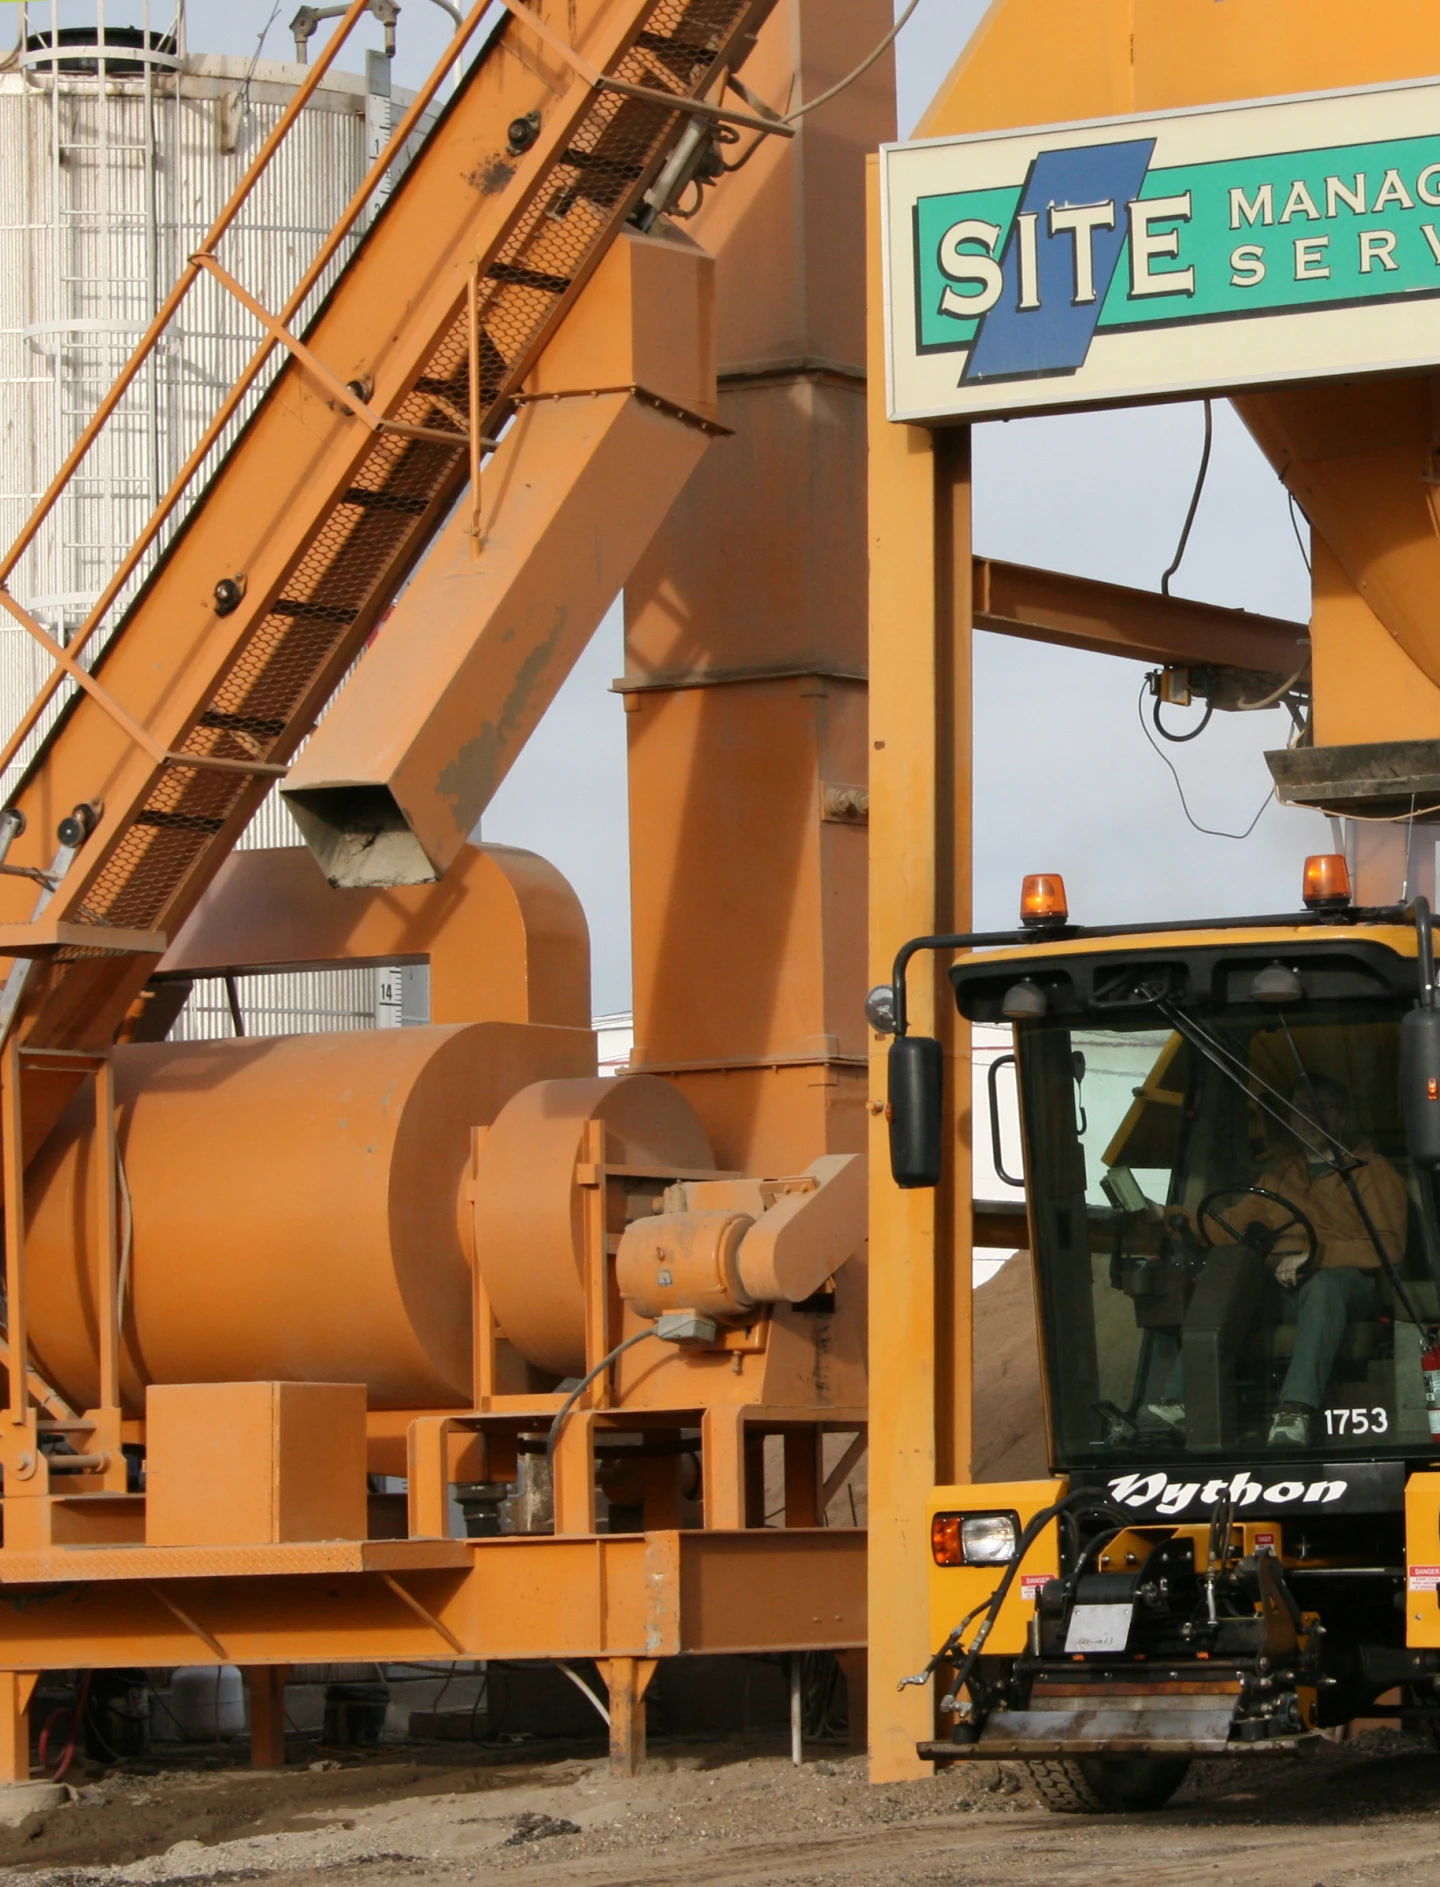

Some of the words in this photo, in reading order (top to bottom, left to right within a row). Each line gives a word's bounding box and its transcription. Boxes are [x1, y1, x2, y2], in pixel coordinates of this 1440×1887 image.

[936, 189, 1195, 321] SITE
[381, 983, 392, 1000] 14
[1324, 1407, 1388, 1434] 1753
[1107, 1471, 1348, 1515] Python
